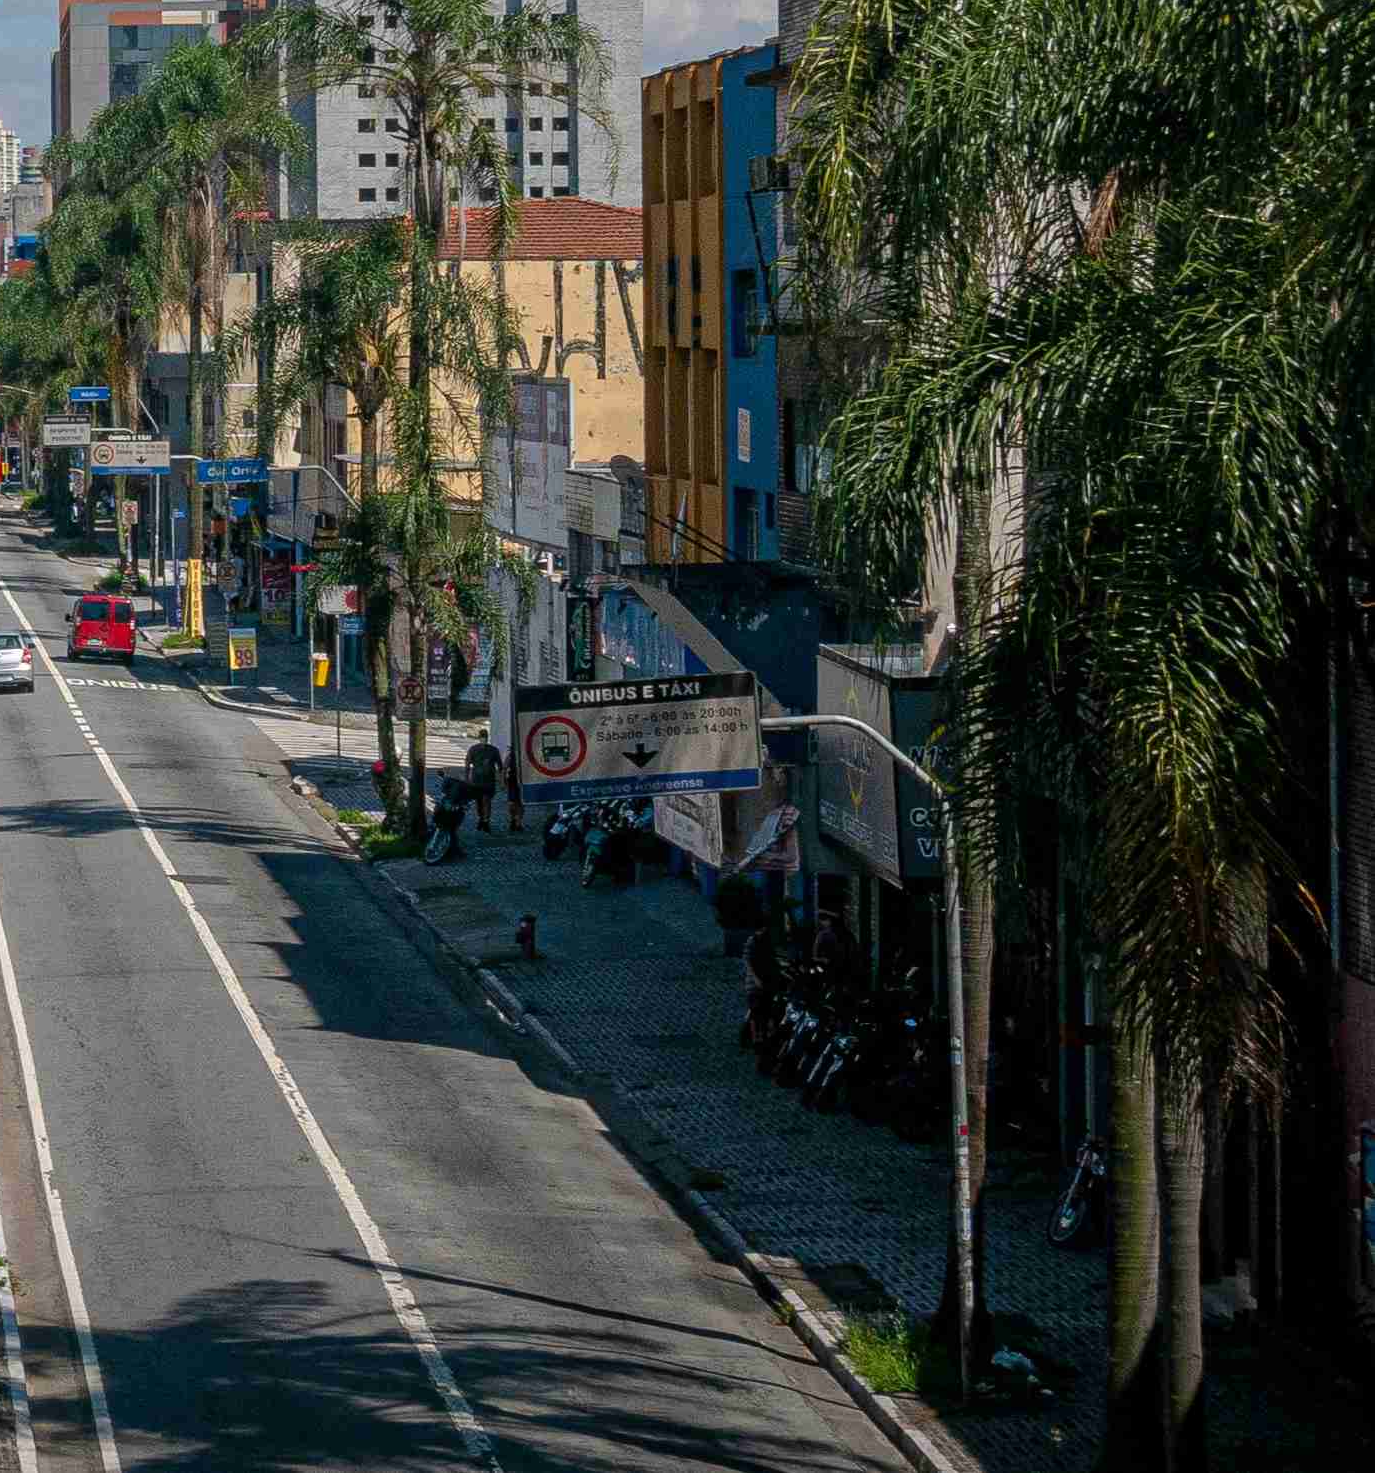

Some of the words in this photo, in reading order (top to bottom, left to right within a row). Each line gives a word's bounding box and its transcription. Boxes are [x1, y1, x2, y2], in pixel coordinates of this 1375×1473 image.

[569, 684, 638, 705] ÔNIBUS
[642, 684, 655, 699] E
[658, 680, 700, 697] TÁXI
